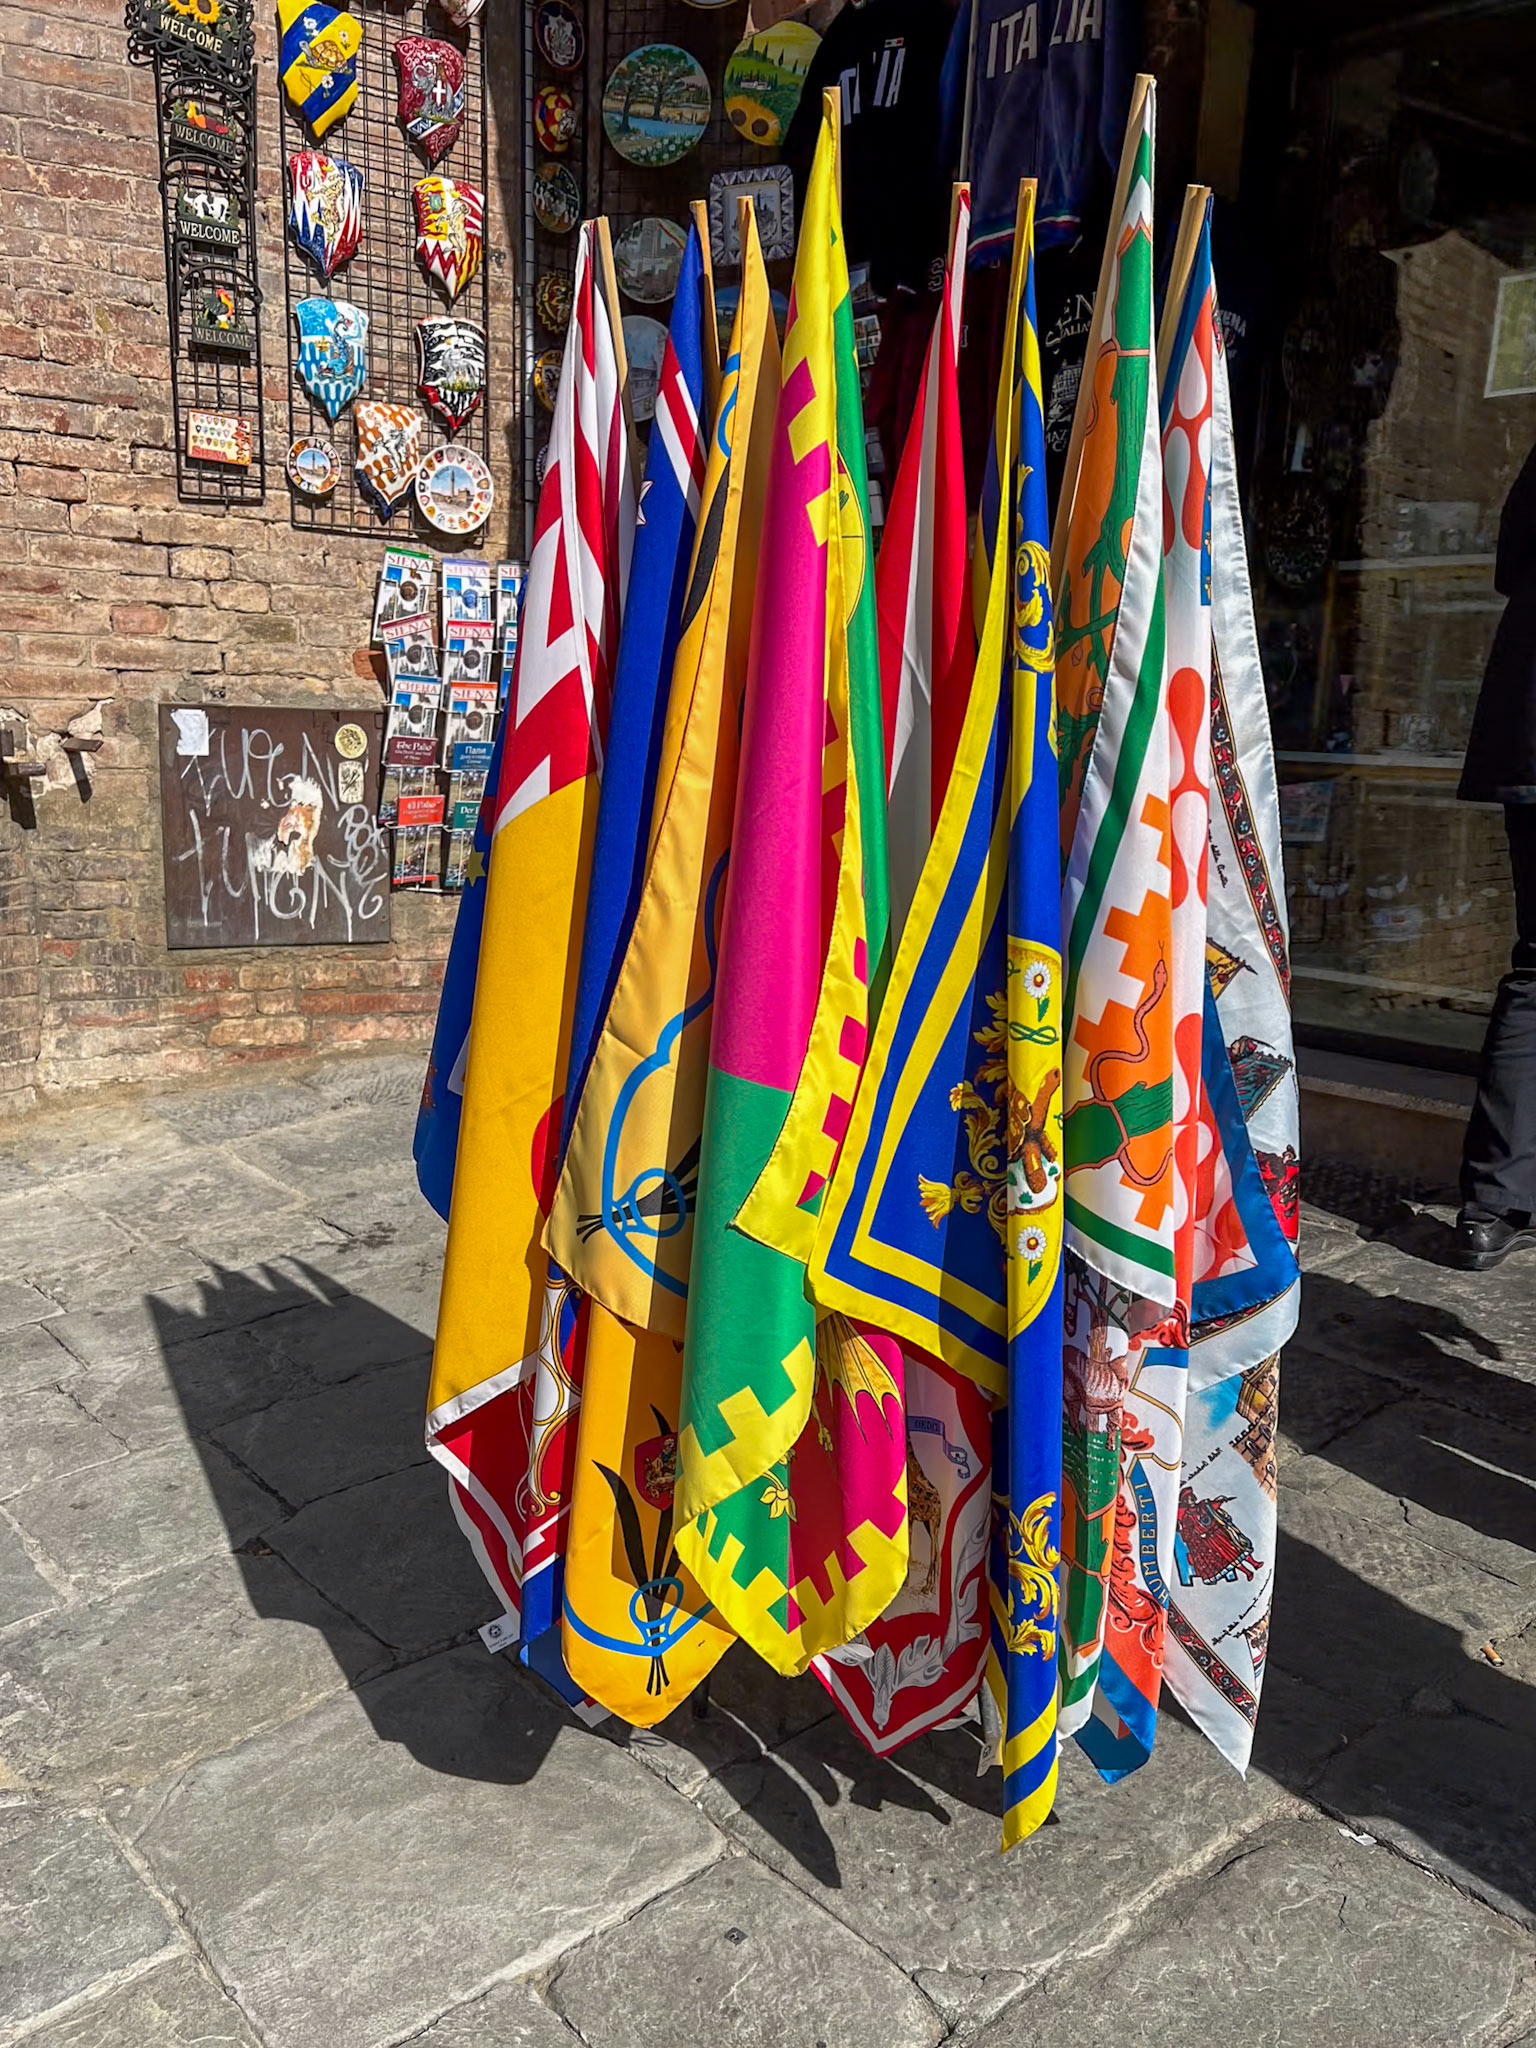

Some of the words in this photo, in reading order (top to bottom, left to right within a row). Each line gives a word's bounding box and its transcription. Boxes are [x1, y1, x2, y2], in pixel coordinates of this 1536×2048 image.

[160, 14, 223, 54] WELCOME
[174, 121, 234, 155] WELCOME
[179, 220, 240, 245] WELCOME
[194, 327, 253, 348] WELCOME
[191, 445, 228, 460] SIENA
[387, 554, 431, 572] SIENA
[445, 565, 488, 577] SIENA
[500, 567, 519, 577] SIE
[385, 619, 430, 638] SIENA
[450, 627, 493, 638] SIENA
[397, 682, 438, 694] СИЕНА
[453, 689, 495, 700] SIENA
[396, 741, 412, 750] The
[1134, 1481, 1170, 1605] HUMBERTI
